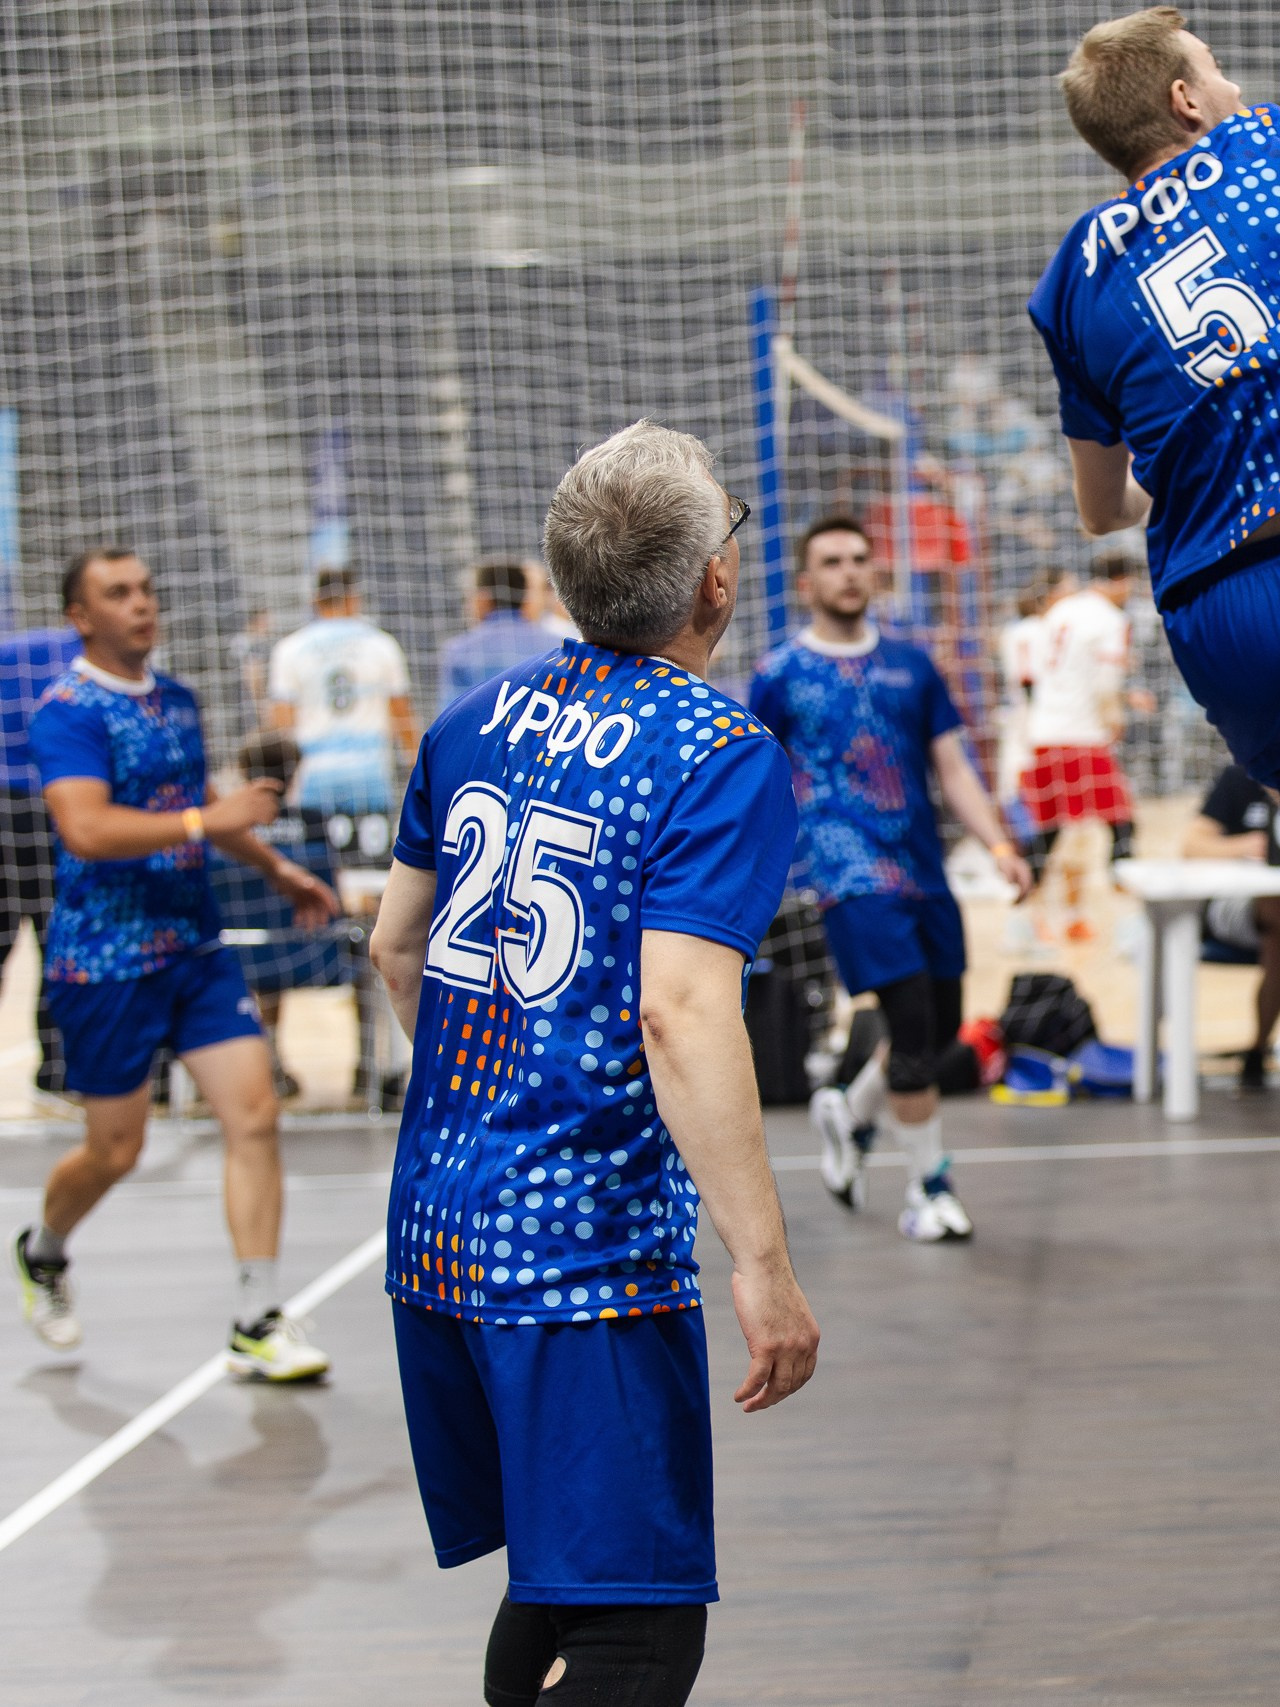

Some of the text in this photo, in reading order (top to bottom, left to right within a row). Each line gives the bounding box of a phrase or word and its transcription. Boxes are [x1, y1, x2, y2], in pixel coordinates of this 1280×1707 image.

[1081, 152, 1224, 278] УРФО
[1136, 225, 1276, 389] 5
[479, 680, 635, 769] УРФО
[423, 780, 604, 1009] 25
